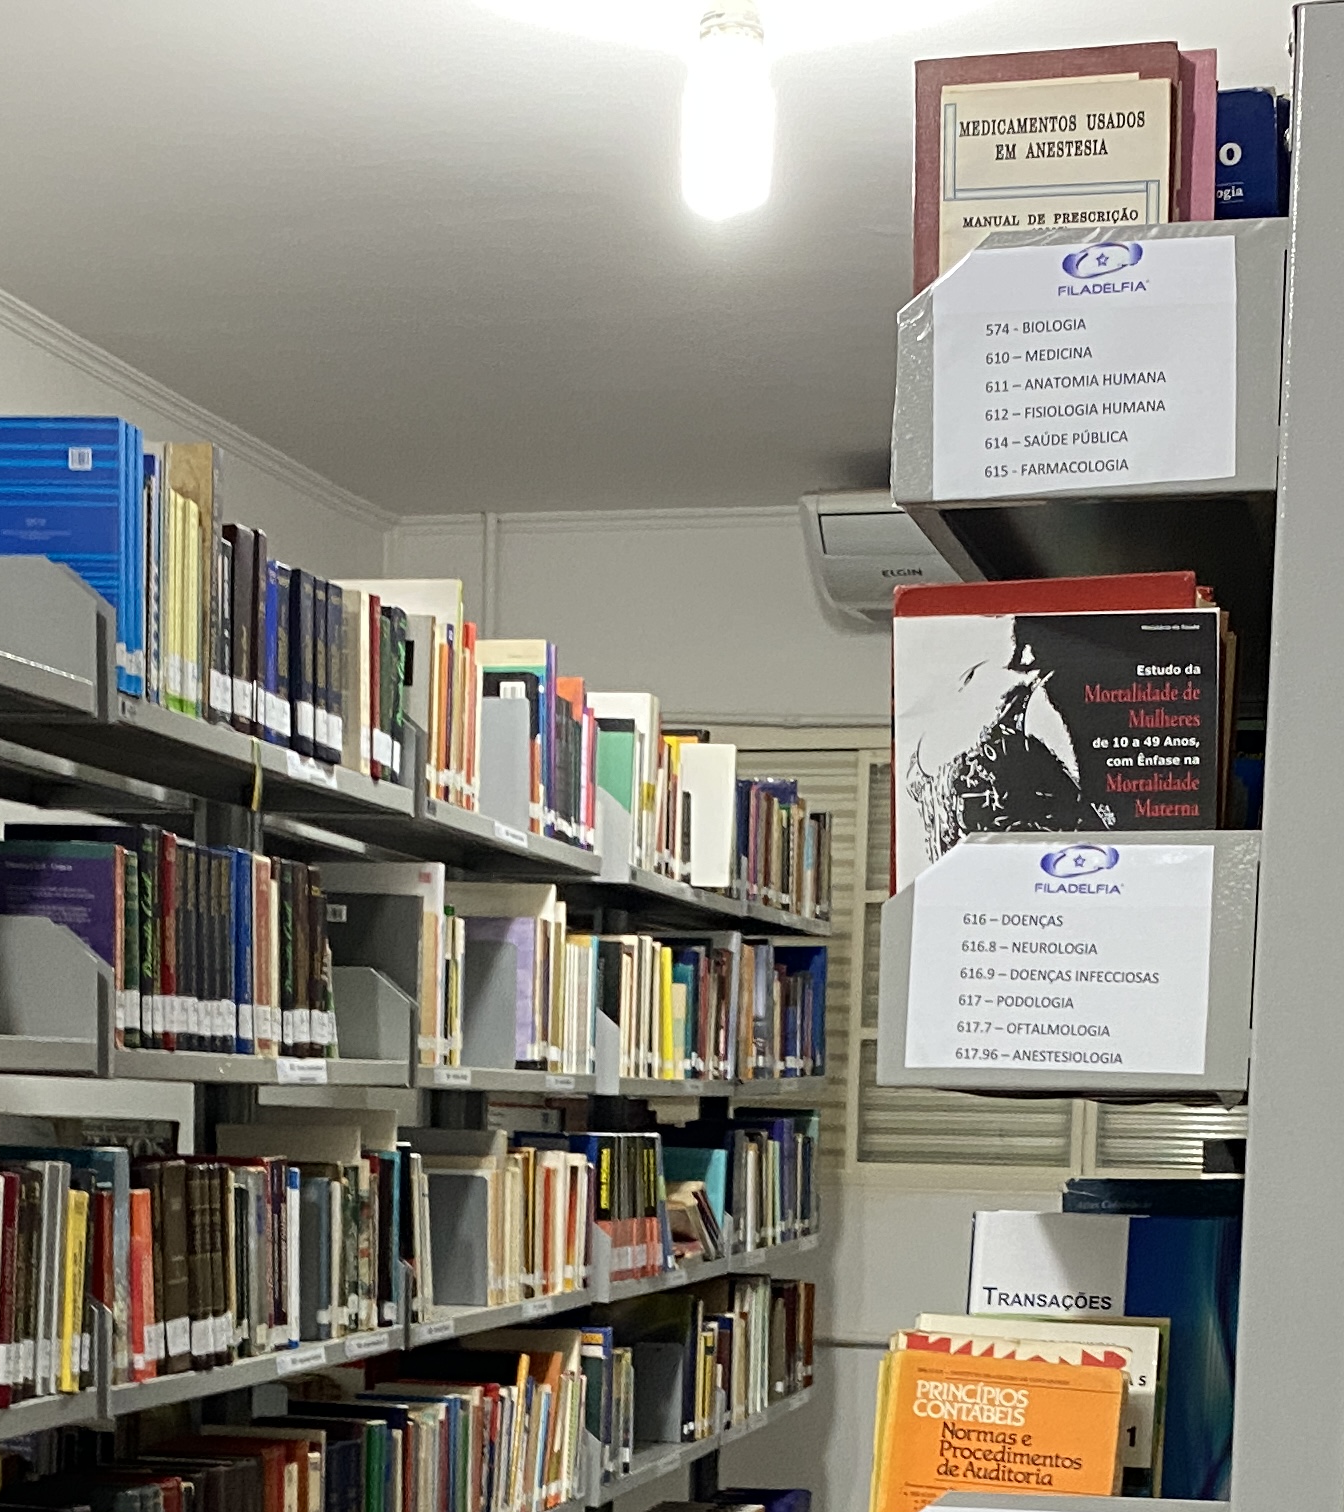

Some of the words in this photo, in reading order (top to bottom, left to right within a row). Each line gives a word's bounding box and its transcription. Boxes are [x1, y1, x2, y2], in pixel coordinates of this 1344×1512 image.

[959, 115, 1076, 137] MEDICAMENTOS
[1087, 111, 1144, 130] USADOS
[996, 144, 1016, 160] EM
[1026, 139, 1108, 159] ANESTESIA
[963, 216, 1019, 228] MANUAL
[1028, 214, 1045, 225] DE
[1054, 208, 1139, 224] PRESCRIÇÃO
[1058, 281, 1146, 296] FILADELFIA
[986, 324, 1009, 336] 574
[1023, 319, 1086, 333] BIOLOGIA
[986, 352, 1009, 364] 610
[1026, 347, 1092, 361] MEDICINA
[986, 381, 1008, 393] 611
[1025, 375, 1099, 390] ANATOMIA
[1103, 372, 1166, 385] HUMANA
[986, 409, 1008, 421] 612
[1025, 404, 1098, 418] FISIOLOGIA
[1103, 400, 1165, 414] HUMANA
[985, 437, 1008, 449] 614
[1024, 432, 1068, 447] SAÚDE
[1072, 430, 1128, 445] PÚBLICA
[985, 465, 1008, 478] 615
[1022, 459, 1128, 476] FARMACOLOGIA
[882, 569, 922, 577] ELGIN
[1137, 665, 1181, 675] Estudo
[1185, 664, 1200, 674] da
[1085, 684, 1178, 702] Mortalidade
[1182, 682, 1201, 700] de
[1130, 709, 1200, 728] Mulheres
[1093, 738, 1108, 748] de
[1113, 737, 1128, 747] 10
[1132, 739, 1139, 747] a
[1144, 737, 1160, 746] 49
[1164, 737, 1199, 748] Anos,
[1107, 758, 1133, 766] com
[1137, 753, 1180, 767] Ênfase
[1107, 774, 1198, 792] Mortalidade
[1136, 801, 1198, 816] Materna
[1035, 883, 1120, 894] FILADELFIA
[964, 914, 986, 925] 616
[1002, 915, 1063, 929] DOENÇAS
[962, 941, 996, 952] 616.8
[1012, 942, 1097, 954] NEUROLOGIA
[961, 968, 994, 979] 616.9
[1010, 969, 1071, 983] DOENÇAS
[1076, 971, 1159, 983] INFECCIOSAS
[959, 995, 981, 1006] 617
[997, 996, 1073, 1008] PODOLOGIA
[957, 1021, 991, 1032] 617.7
[1007, 1023, 1110, 1036] OFTALMOLOGIA
[956, 1048, 998, 1060] 617.96
[1013, 1050, 1122, 1064] ANESTESIOLOGIA
[983, 1286, 1112, 1311] TRANSAÇÕES
[916, 1380, 1029, 1408] PRINCÍPIOS
[942, 1422, 1017, 1445] Normas
[1022, 1434, 1032, 1446] e
[940, 1441, 1082, 1470] Procedimentos
[937, 1459, 959, 1476] de
[963, 1463, 1052, 1486] Auditoria
